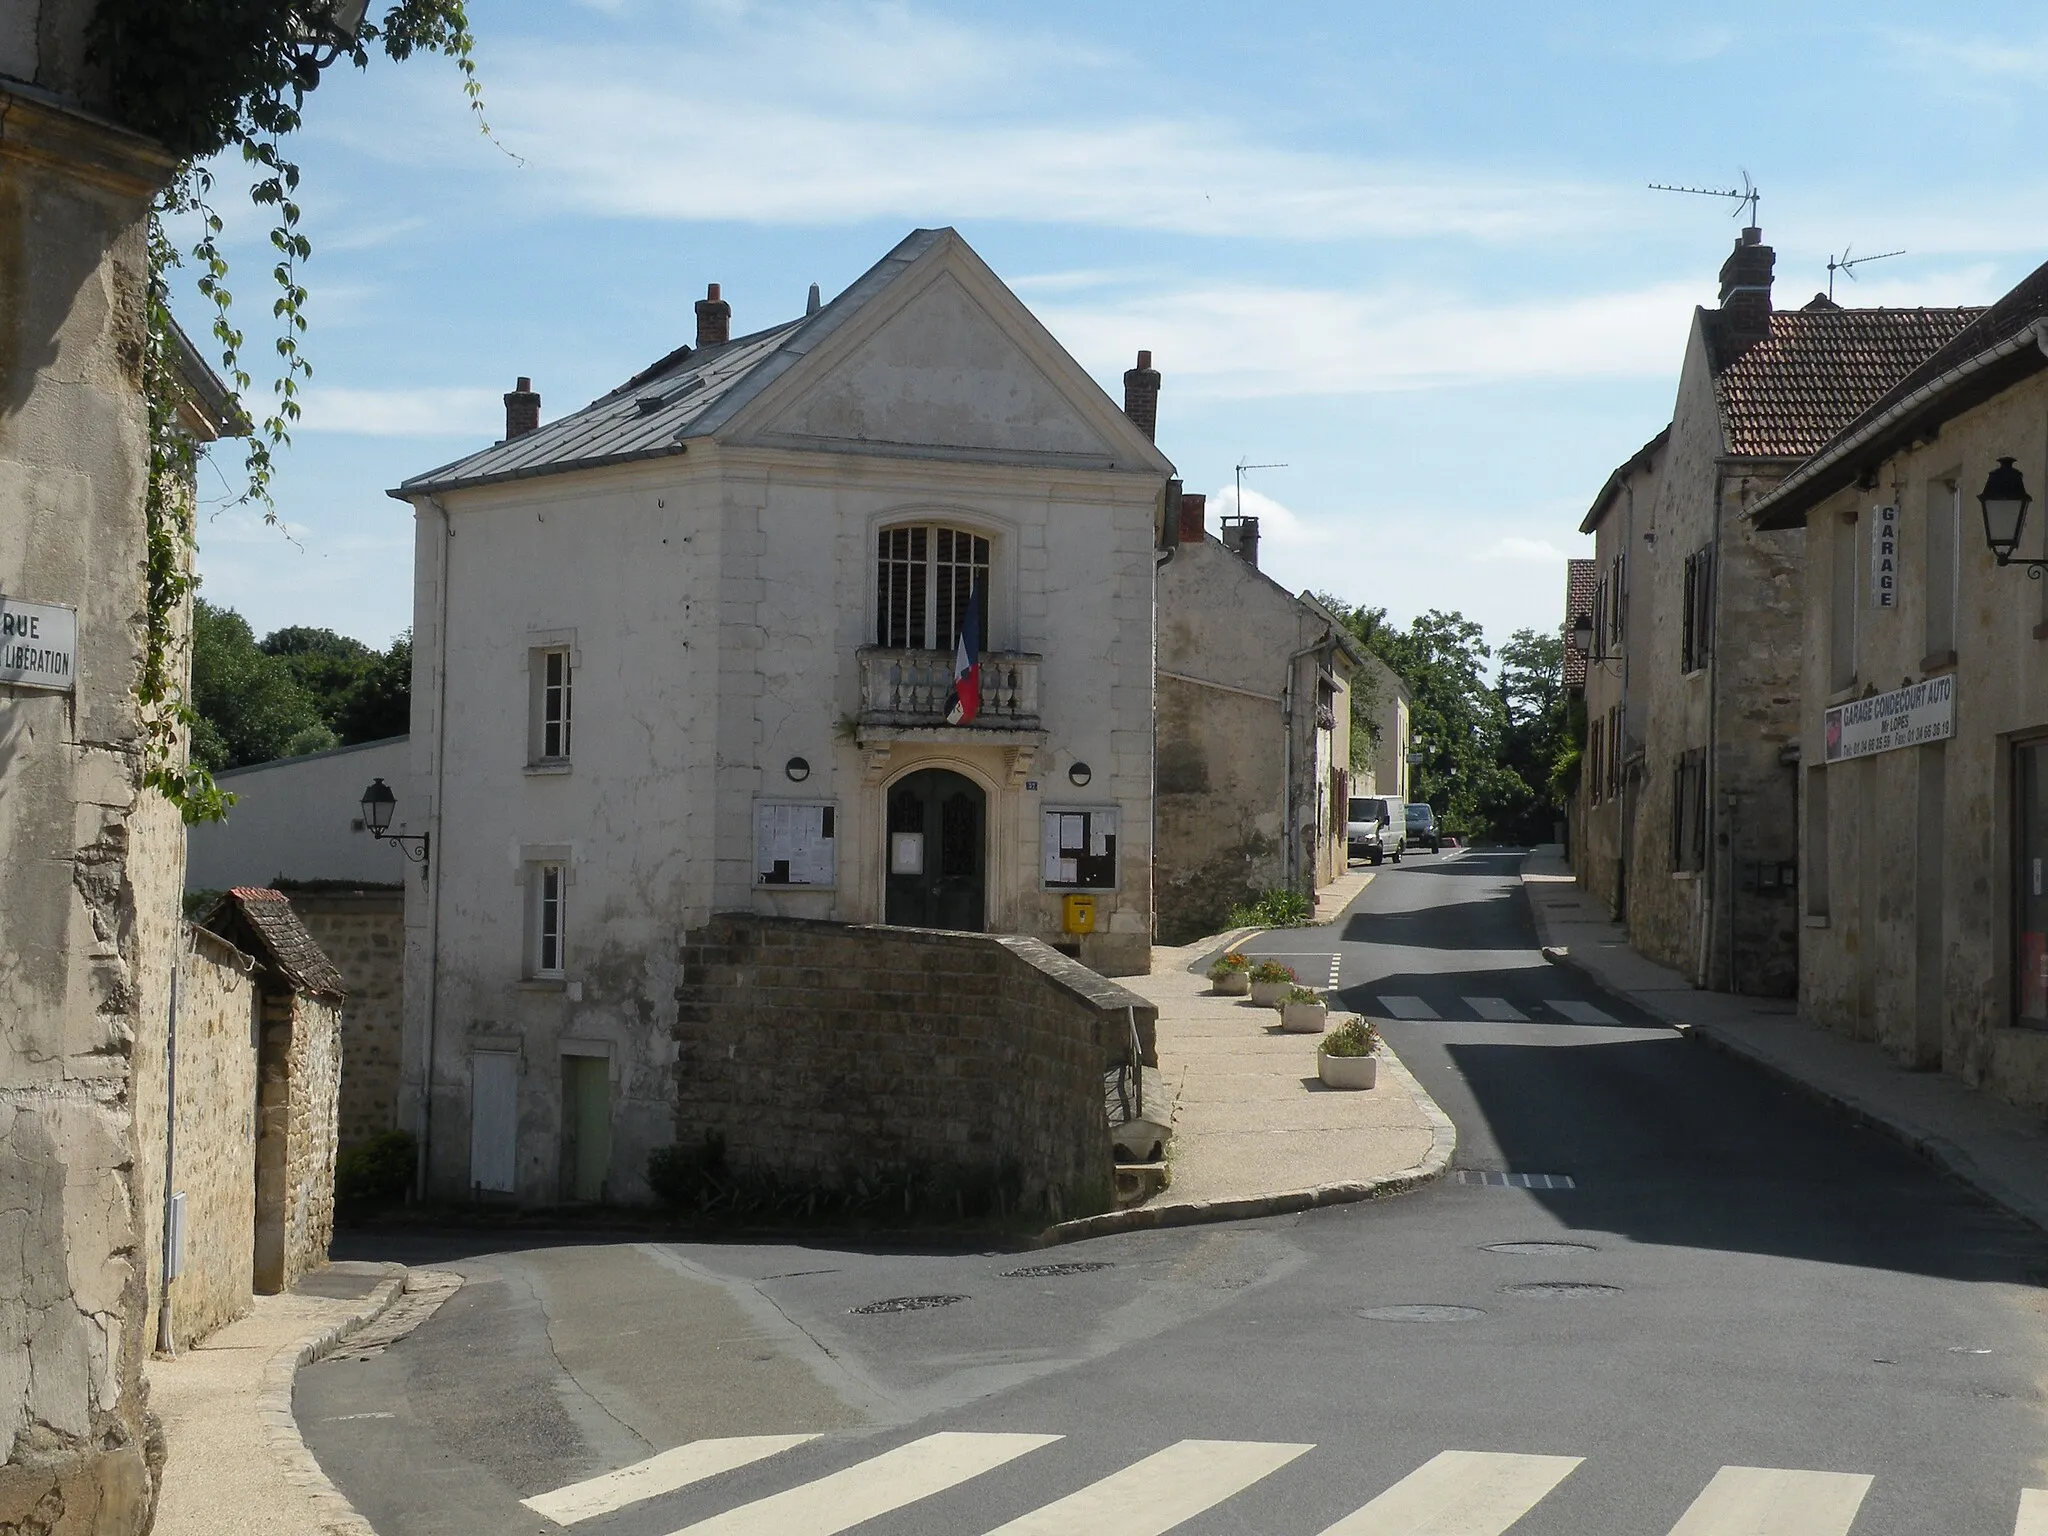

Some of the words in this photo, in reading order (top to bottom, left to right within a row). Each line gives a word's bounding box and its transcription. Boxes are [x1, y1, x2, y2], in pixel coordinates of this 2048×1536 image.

[1880, 507, 1894, 606] GARAGE
[3, 612, 40, 639] RUE
[5, 644, 69, 675] LIBÉRATION
[1843, 700, 1873, 727] GARAGE
[1874, 685, 1927, 719] CONDECOURT
[1927, 678, 1951, 705] AUTO
[1890, 714, 1909, 731] LOPES
[1907, 729, 1914, 742] 01
[1915, 727, 1923, 740] 34
